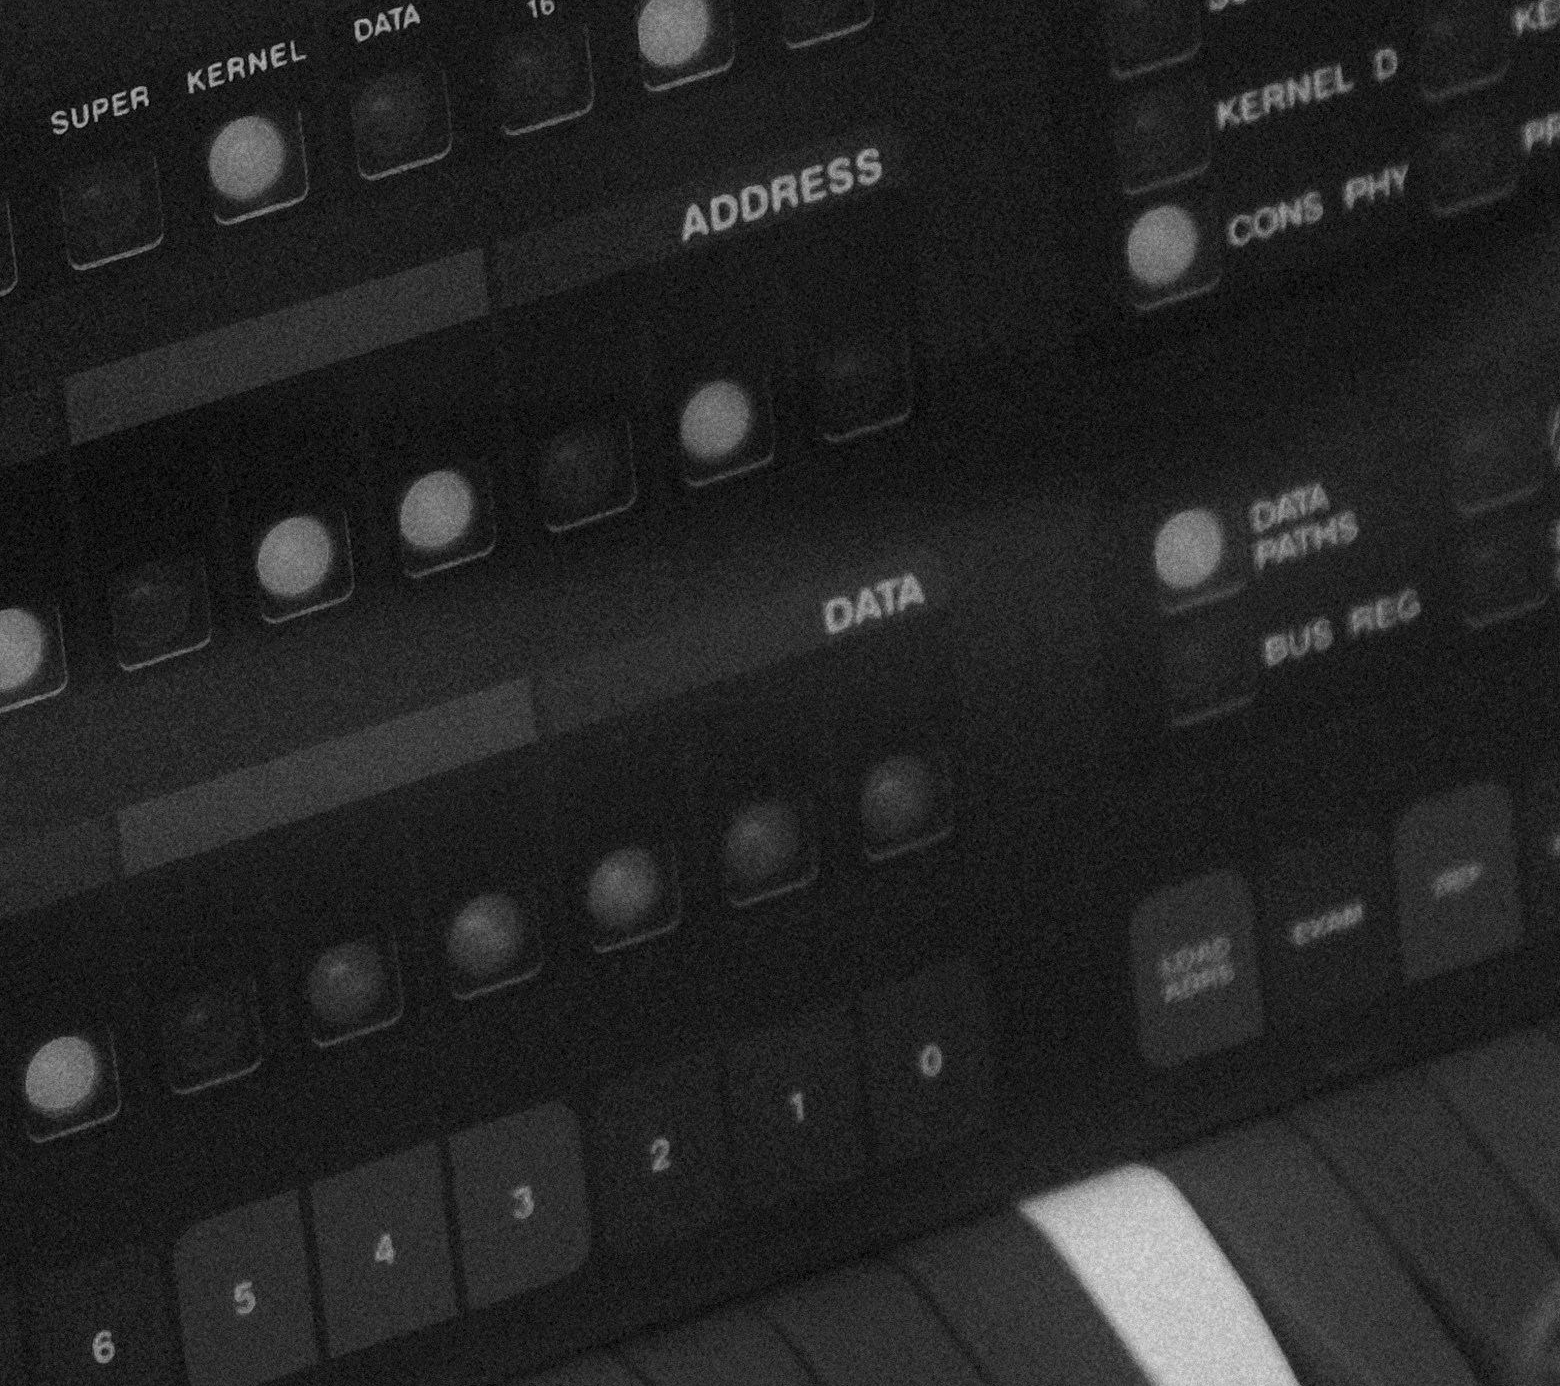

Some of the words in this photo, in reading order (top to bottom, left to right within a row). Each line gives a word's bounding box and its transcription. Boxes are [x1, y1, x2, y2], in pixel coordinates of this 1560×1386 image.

[353, 3, 421, 43] DATA
[186, 41, 307, 94] KERNEL
[1215, 65, 1353, 129] KERNEL
[1373, 46, 1399, 82] D
[49, 85, 150, 136] SUPER
[681, 147, 883, 242] ADDRESS
[1227, 191, 1324, 247] CONS
[1342, 165, 1408, 209] PHY
[1250, 483, 1330, 533] DATA
[1255, 510, 1359, 569] PATHS
[823, 573, 925, 635] DATA
[1262, 618, 1333, 667] BUS
[1348, 588, 1421, 635] REG
[91, 1329, 116, 1365] 6
[233, 1280, 257, 1316] 5
[374, 1233, 396, 1264] 4
[512, 1185, 535, 1220] 3
[649, 1137, 671, 1173] 2
[789, 1091, 805, 1121] 1
[918, 1043, 944, 1078] 0
